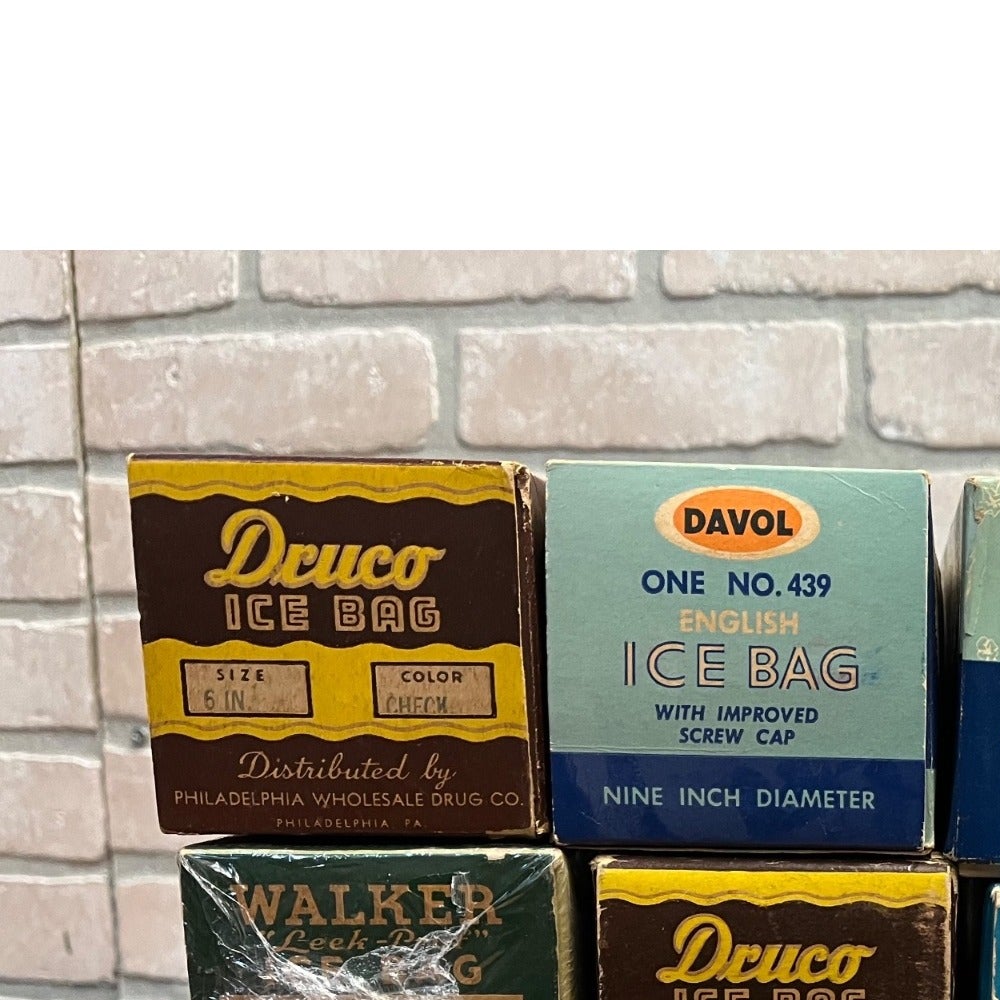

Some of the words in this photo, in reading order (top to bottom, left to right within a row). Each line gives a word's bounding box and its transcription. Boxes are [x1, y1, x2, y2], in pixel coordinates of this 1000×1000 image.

[684, 508, 793, 537] DAVOL
[204, 508, 446, 590] Druco
[641, 570, 705, 595] ONE
[226, 594, 309, 631] ICE
[335, 596, 441, 632] BAG
[679, 609, 799, 634] ENGLISH
[217, 669, 265, 682] SIZE
[401, 671, 463, 684] COLOR
[624, 641, 725, 688] ICE
[749, 646, 859, 691] BAG
[204, 690, 215, 710] 6
[655, 705, 705, 721] WITH
[717, 706, 819, 724] IMPROVED
[679, 728, 744, 744] SCREW
[756, 729, 795, 745] CAP
[238, 751, 409, 780] Distributed
[420, 754, 457, 789] by
[175, 790, 303, 806] PHILADELPHIA
[312, 792, 425, 808] WHOLESALE
[431, 792, 483, 806] DRUG
[491, 792, 524, 806] CO.
[603, 786, 663, 806] NINE
[679, 788, 740, 808] INCH
[757, 789, 875, 810] DIAMETER
[277, 819, 389, 829] PHILADELPHIA
[230, 884, 503, 926] WALKER
[656, 914, 877, 983] Druco
